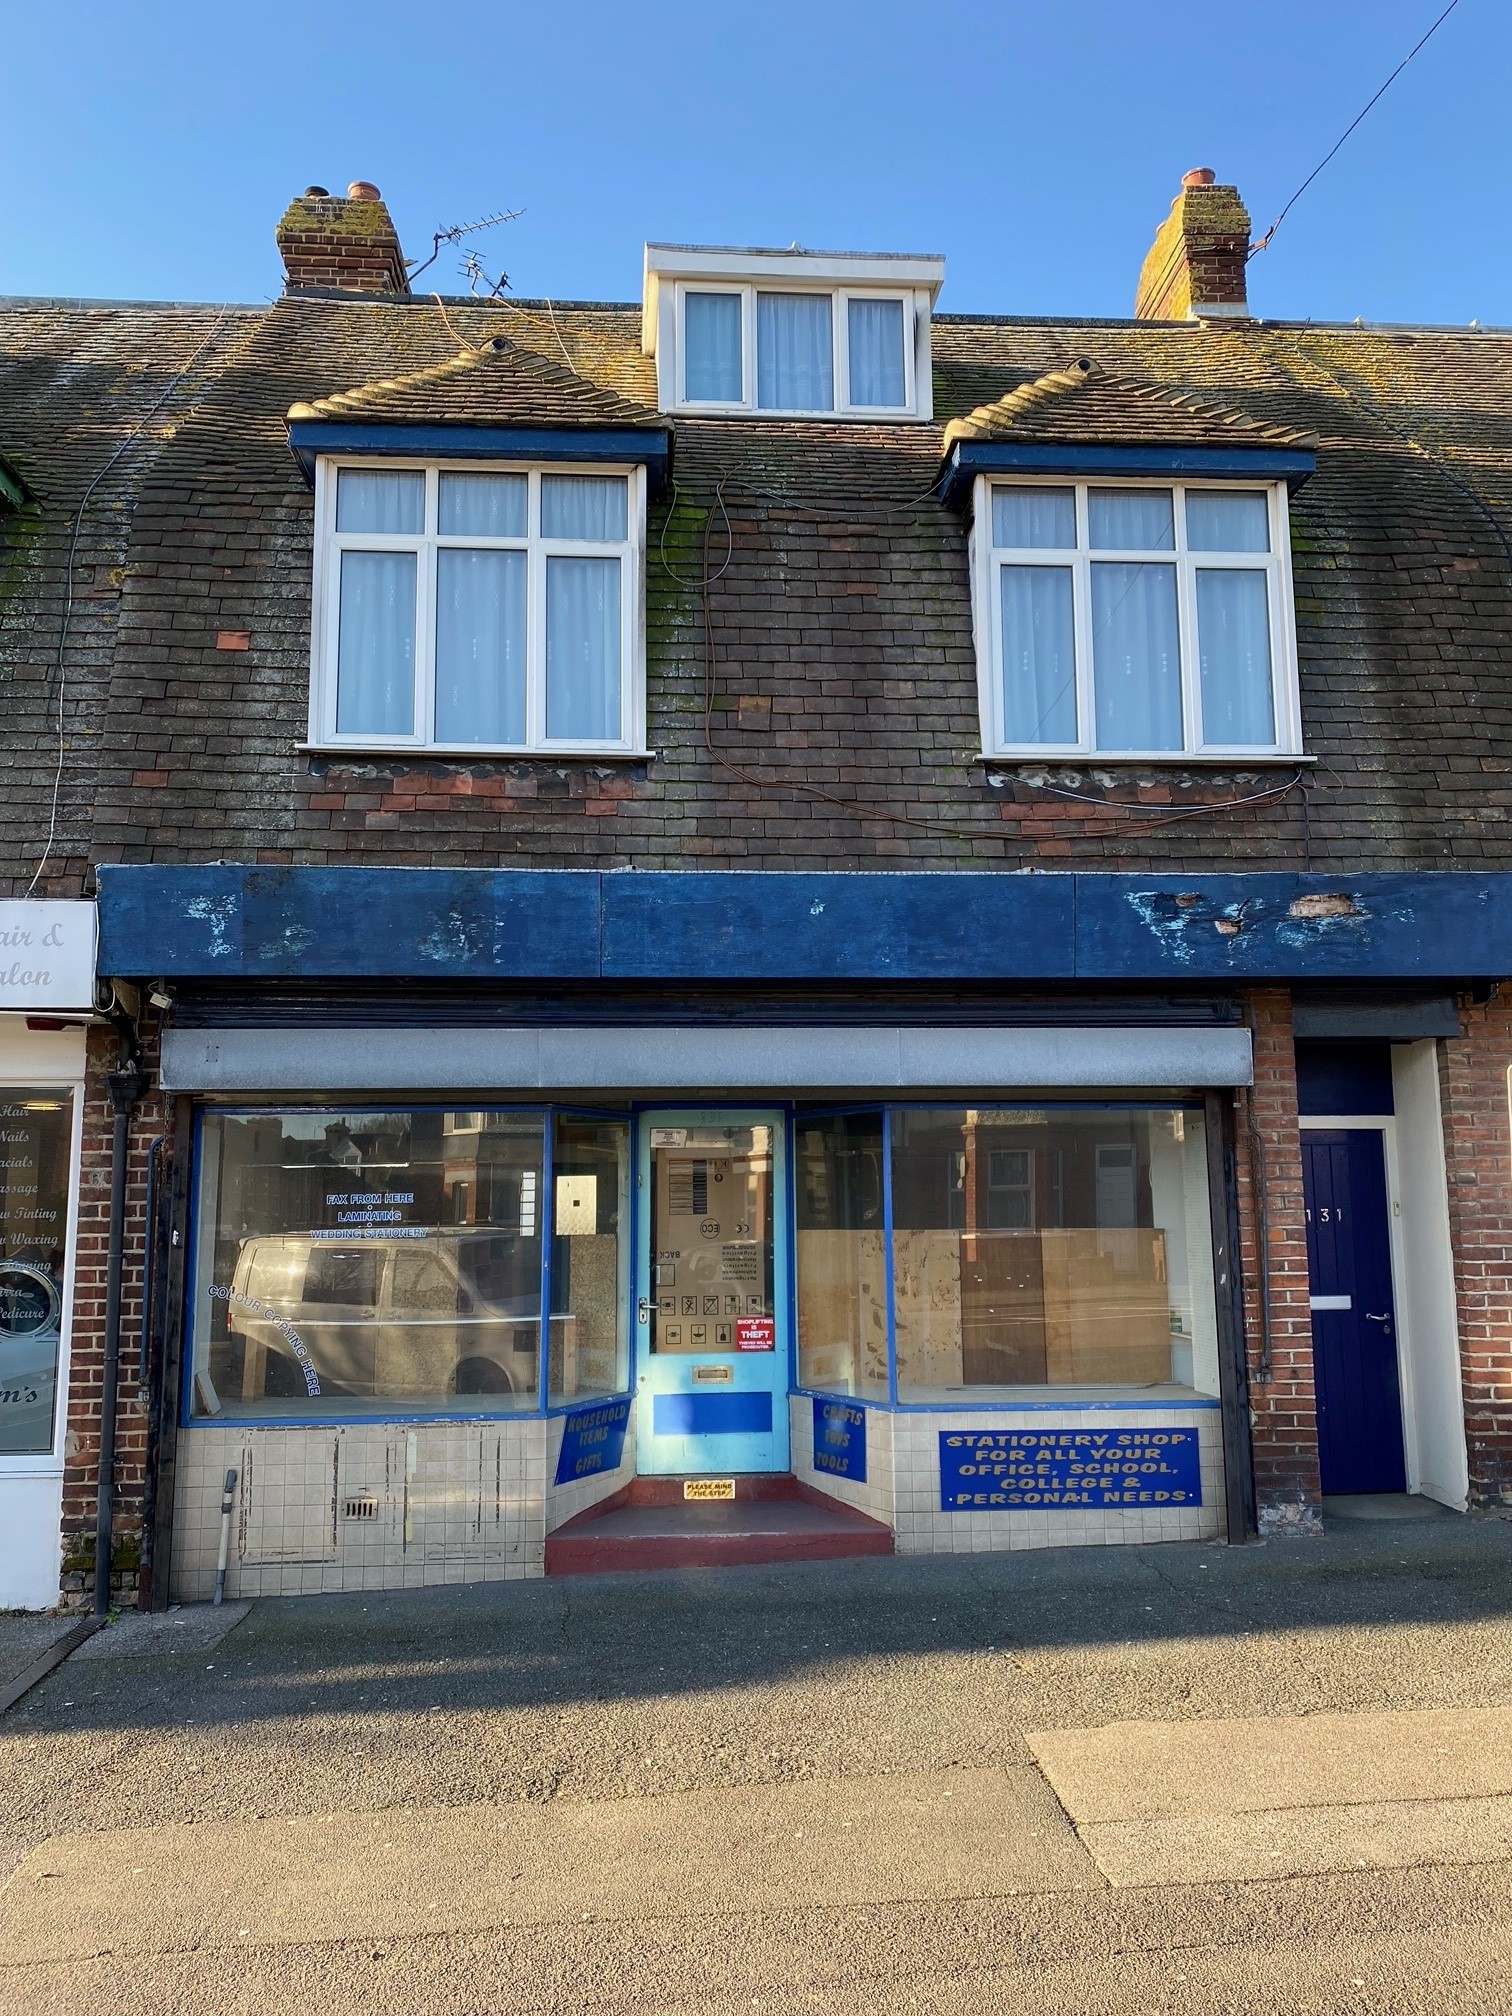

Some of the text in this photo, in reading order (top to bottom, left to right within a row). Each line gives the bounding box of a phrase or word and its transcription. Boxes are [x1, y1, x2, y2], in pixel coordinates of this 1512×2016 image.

[42, 923, 65, 947] &
[0, 1105, 29, 1117] Hair
[0, 1130, 29, 1142] Nails
[327, 1192, 414, 1205] FAX FROM HERE
[14, 1207, 57, 1222] Tinting
[338, 1210, 402, 1222] LAMINATING
[1306, 1208, 1342, 1222] 131
[310, 1227, 429, 1240] WEDDING STATIONERY
[701, 1224, 719, 1233] ECO
[10, 1233, 59, 1248] Waxing
[659, 1251, 681, 1259] BACK
[208, 1285, 321, 1397] COLOUR COPYING HERE
[567, 1404, 626, 1433] HOUSEHOLD
[823, 1404, 863, 1426] CRAFTS
[579, 1425, 609, 1447] ITEMS
[825, 1429, 850, 1447] TOYS
[947, 1434, 1186, 1447] STATIONERY SHOP
[815, 1451, 848, 1472] TOOLS
[975, 1448, 1161, 1461] FOR ALL YOUR
[575, 1452, 602, 1474] GIFTS
[959, 1462, 1179, 1476] OFFICE, SCHOOL,
[1000, 1476, 1141, 1489] COLLEGE &
[956, 1491, 1186, 1505] PERSONAL NEEDS
